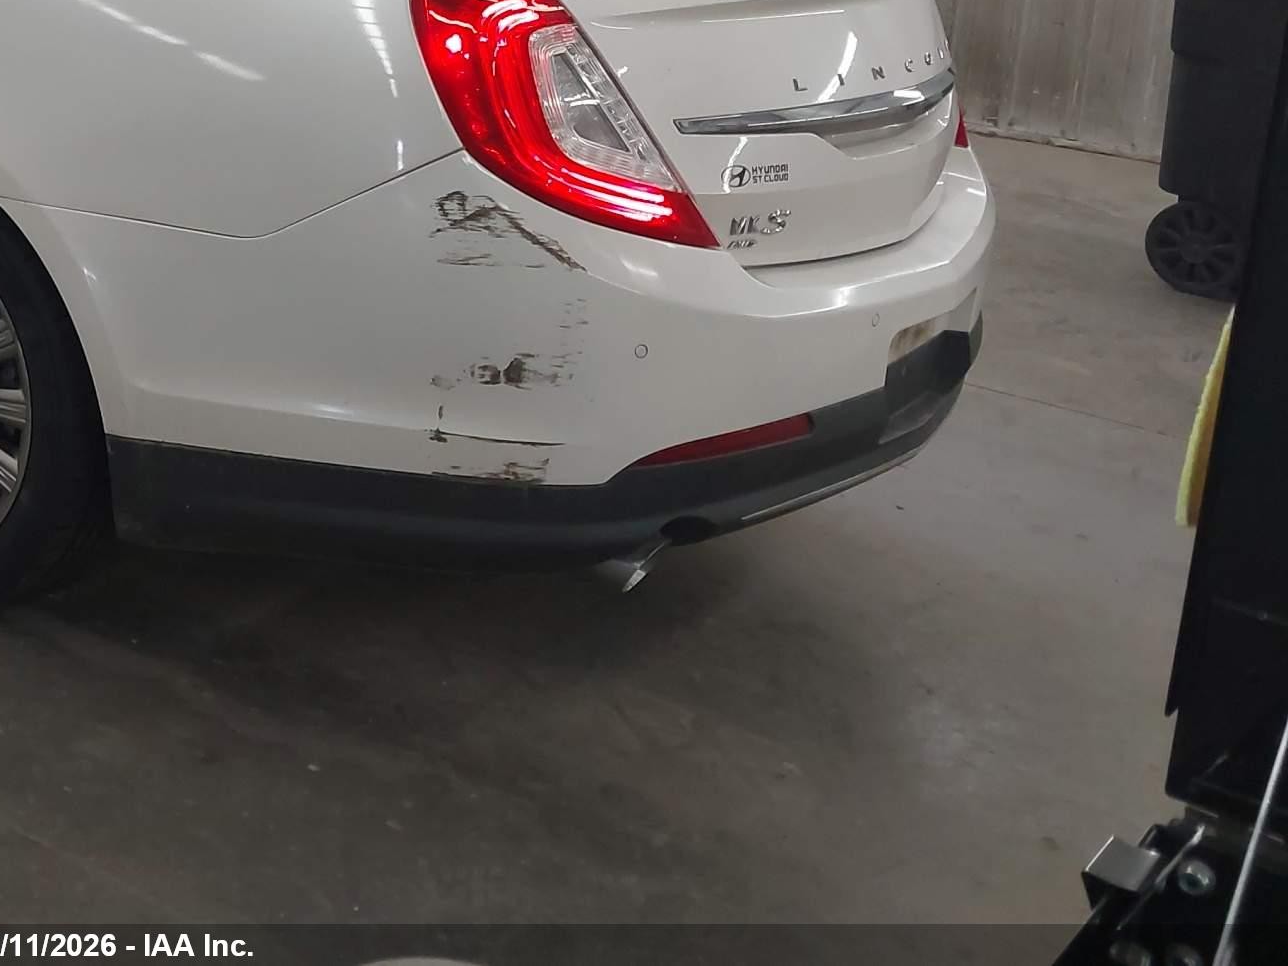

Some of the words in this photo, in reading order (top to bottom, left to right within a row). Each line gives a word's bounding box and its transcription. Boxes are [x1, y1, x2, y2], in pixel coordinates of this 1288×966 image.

[752, 164, 789, 175] HYUNDAI
[752, 175, 762, 184] ST
[764, 173, 789, 183] CLOUD
[730, 209, 791, 236] MKS
